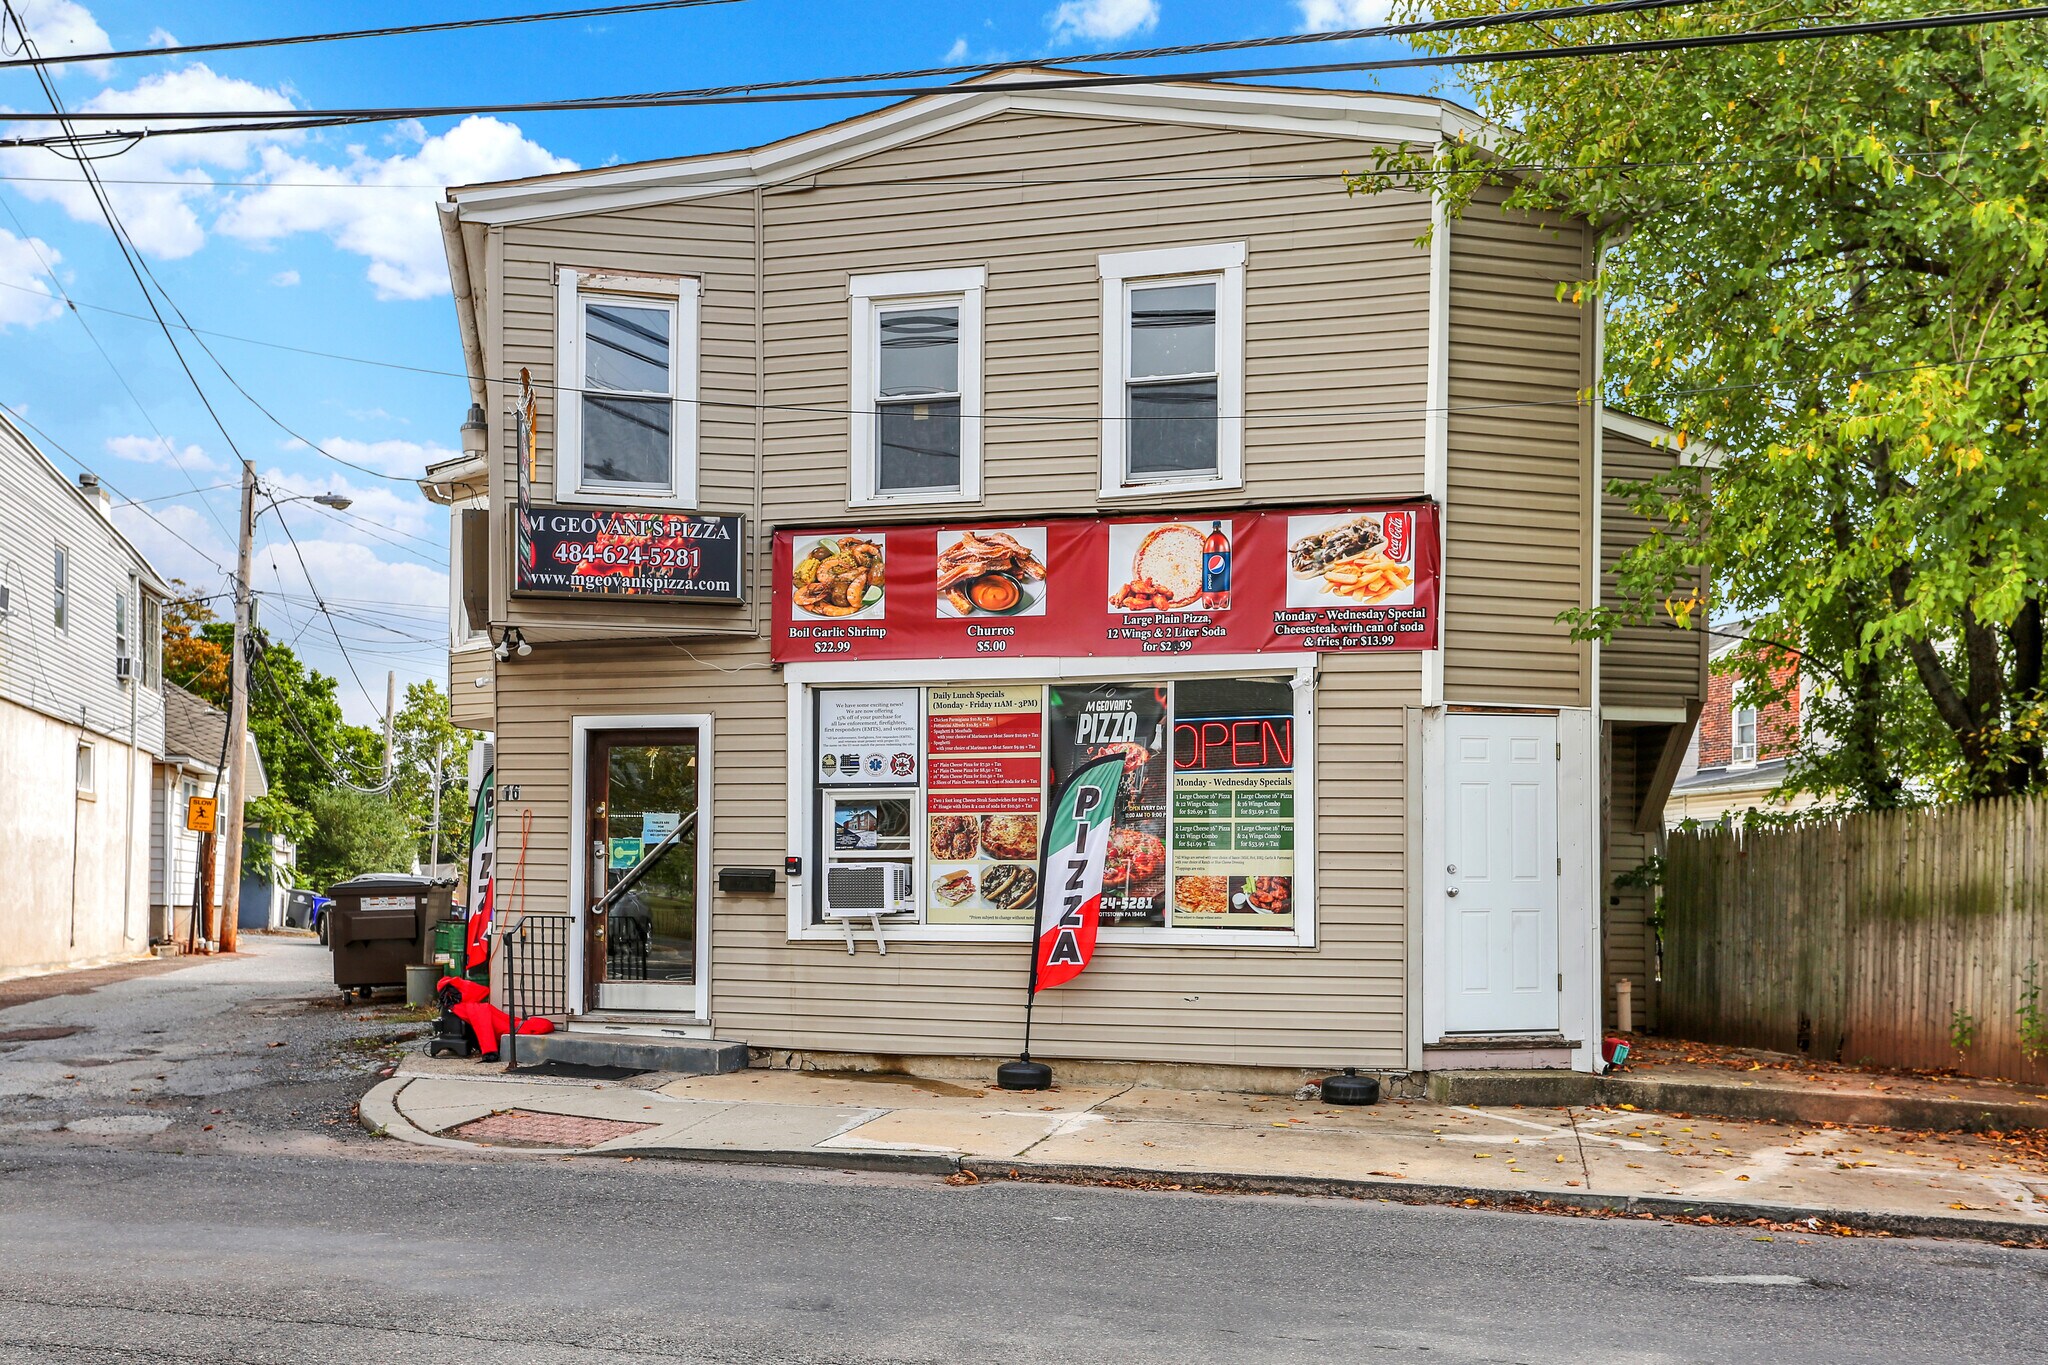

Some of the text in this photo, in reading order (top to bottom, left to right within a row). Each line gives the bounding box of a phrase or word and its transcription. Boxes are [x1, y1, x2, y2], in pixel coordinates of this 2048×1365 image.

[530, 516, 730, 539] M GEOVANI'S PIZZA
[554, 543, 700, 567] 484-624-5281
[530, 572, 730, 592] www.mgeovanispizza.com
[1123, 614, 1211, 626] Large Plain Pizza,
[1274, 608, 1426, 622] Monday Wednesday Special
[789, 625, 886, 640] Boil Garlic Shrimp
[967, 625, 1014, 637] Churros
[1107, 626, 1226, 640] 12 Wings & 2 Liter Soda
[1275, 622, 1424, 634] Cheesesteak with can of soda
[814, 640, 851, 653] $22.99
[976, 639, 1006, 653] $5.00
[1143, 641, 1192, 652] for $2.99
[1304, 635, 1394, 646] & fries for $13.99
[976, 691, 1005, 699] Specials
[933, 701, 964, 709] (Monday
[1018, 700, 1037, 708] 3PM)
[1085, 700, 1132, 712] M GEOVANI'S
[1076, 712, 1138, 744] PIZZA
[1174, 720, 1291, 768] OPEN
[1176, 777, 1292, 787] Monday Wednesday Specials
[501, 785, 521, 800] 16
[1047, 785, 1102, 965] PIZZA
[1100, 897, 1153, 910] 24-5281
